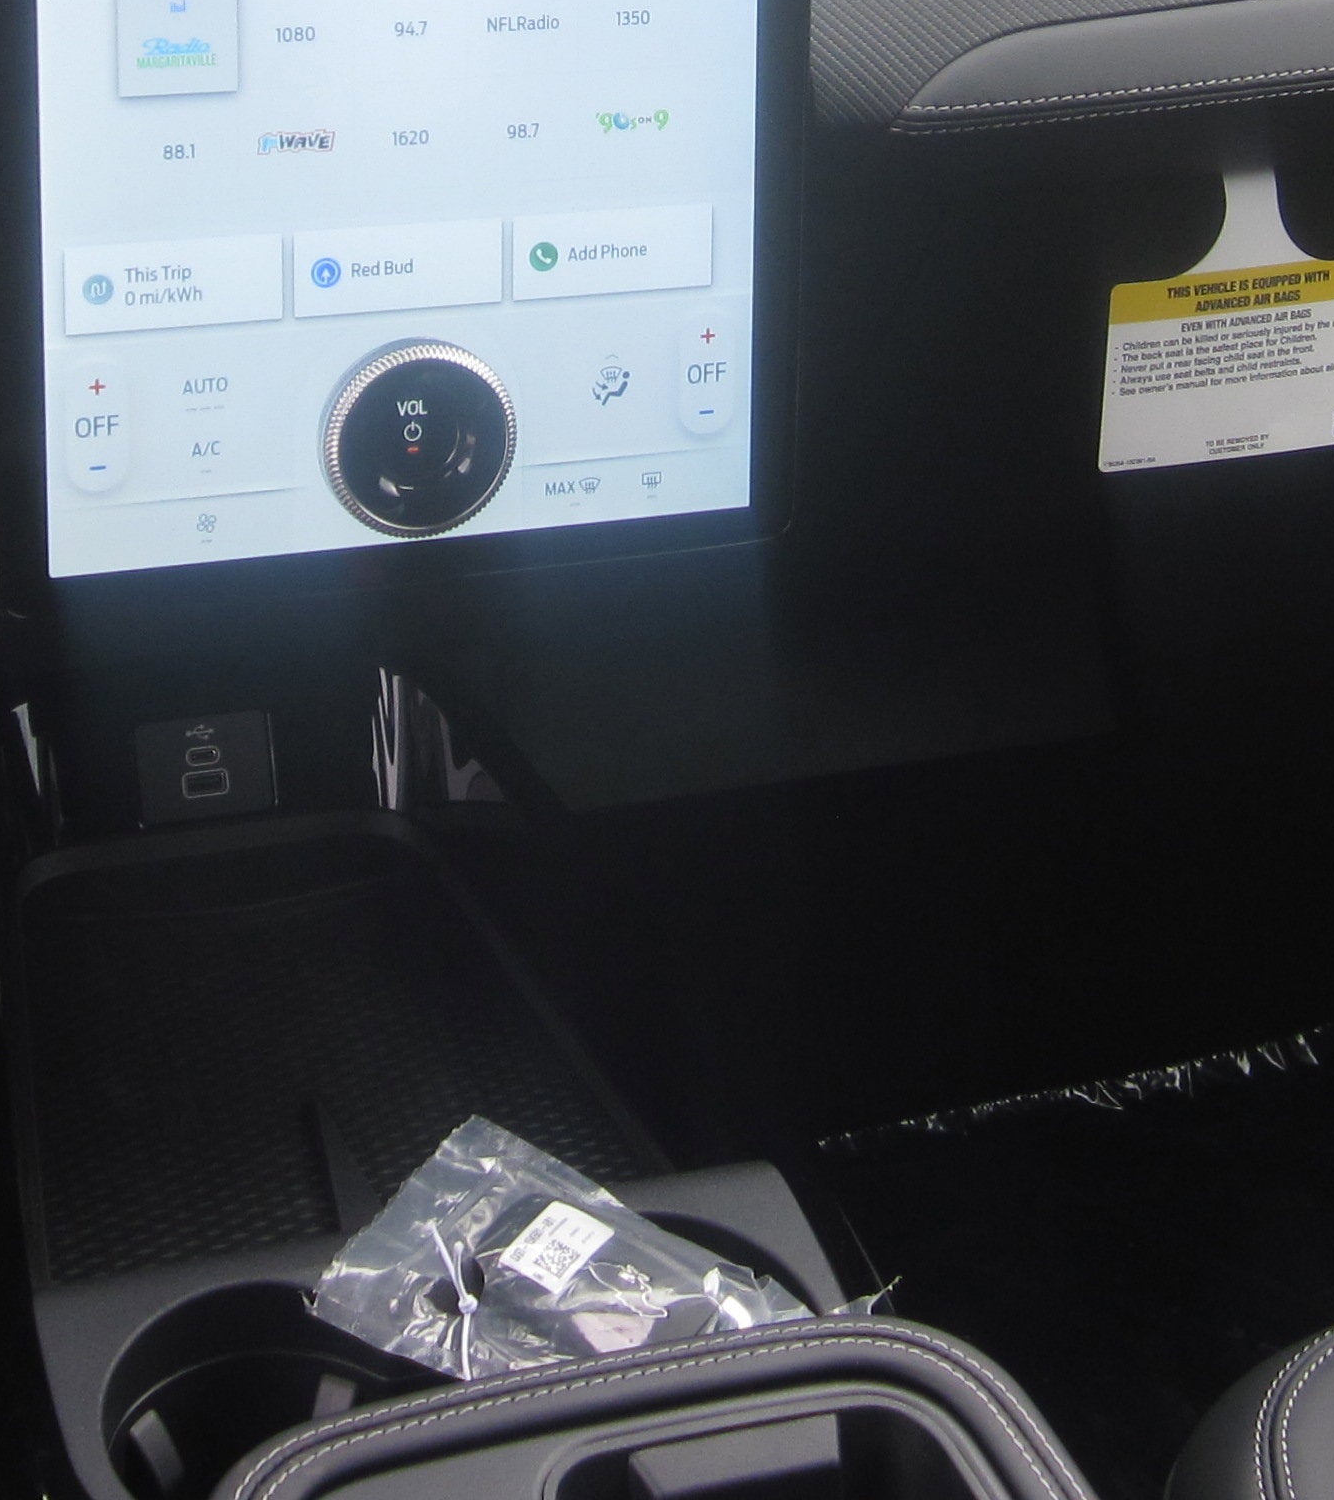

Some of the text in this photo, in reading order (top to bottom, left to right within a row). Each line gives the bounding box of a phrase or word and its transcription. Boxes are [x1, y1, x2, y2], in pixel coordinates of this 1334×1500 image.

[487, 15, 560, 33] NFLRadio
[616, 10, 651, 26] 1350
[276, 26, 316, 43] 1080
[394, 21, 428, 37] 94.7
[653, 109, 669, 131] 9
[393, 130, 429, 146] 1620
[507, 123, 540, 139] 98.7
[163, 144, 196, 160] 88.1
[567, 243, 648, 262] Add Phone
[124, 264, 192, 283] This Trip
[351, 259, 414, 278] Red Bud
[1167, 270, 1330, 299] THIS VEHICLE IS EQUIPPED WITH
[124, 285, 203, 306] 0 mi/kWh
[1195, 290, 1301, 313] ADVANCED AIR BAGS
[1181, 308, 1312, 332] EVEN WITH ADVANCED AIR BAGS
[1123, 340, 1161, 351] Children
[1163, 338, 1179, 347] can
[1182, 336, 1193, 345] be
[1195, 333, 1218, 343] killed
[1221, 332, 1229, 340] or
[1232, 327, 1272, 340] seriously
[1274, 323, 1303, 335] injured
[1305, 321, 1315, 332] by
[1317, 319, 1330, 329] the
[1122, 353, 1139, 362] The
[1141, 350, 1162, 360] back
[1165, 348, 1183, 358] seat
[1197, 345, 1209, 355] the
[1266, 337, 1278, 346] for
[1121, 364, 1146, 373] Never
[1149, 362, 1164, 372] put
[1223, 352, 1244, 362] child
[1247, 350, 1265, 360] seat
[1277, 346, 1290, 356] the
[687, 362, 727, 384] OFF
[1119, 387, 1136, 396] See
[1176, 379, 1208, 390] manual
[1210, 377, 1222, 386] for
[1225, 375, 1248, 385] more
[1249, 368, 1298, 382] information
[1300, 364, 1324, 375] about
[1120, 374, 1153, 384] Always
[1155, 372, 1171, 380] use
[1173, 369, 1192, 379] seat
[1194, 367, 1215, 377] belts
[1218, 365, 1234, 374] and
[1237, 361, 1257, 372] child
[182, 377, 229, 395] AUTO
[397, 400, 428, 417] VOL
[74, 415, 120, 439] OFF
[191, 441, 221, 458] A/C
[545, 481, 576, 497] MAX
